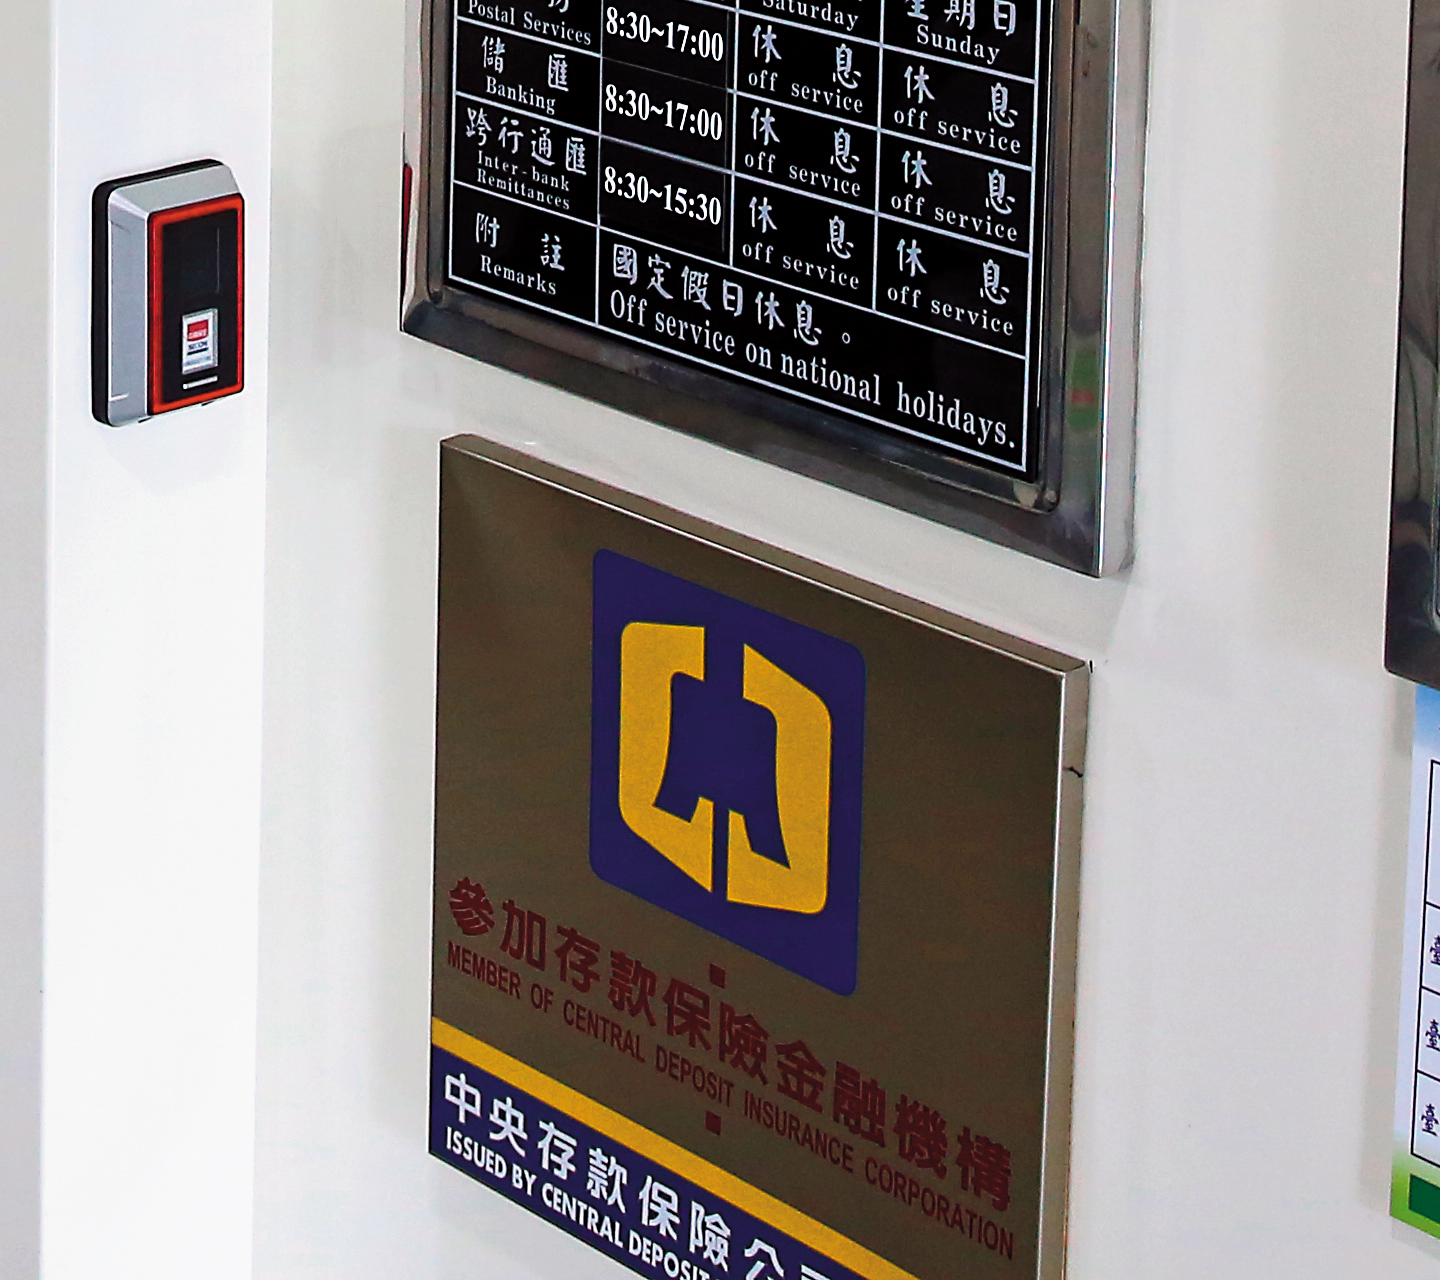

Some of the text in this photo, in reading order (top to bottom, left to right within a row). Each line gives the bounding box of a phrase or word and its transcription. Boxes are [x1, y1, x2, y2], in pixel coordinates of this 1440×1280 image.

[524, 12, 590, 45] Services
[607, 7, 723, 61] 8:30~17:00
[917, 24, 999, 64] Sunday
[482, 36, 568, 91] 儲匯
[753, 25, 861, 89] 休息
[486, 76, 555, 115] Banking
[606, 84, 722, 140] 8:30~17:00
[749, 70, 862, 113] off service
[904, 66, 1018, 127] 休息
[466, 108, 586, 175] 跨行通匯
[751, 107, 859, 173] 休息
[894, 108, 1020, 153] off service
[478, 168, 569, 209] Remittances
[479, 150, 568, 191] Inter-bank
[605, 166, 721, 225] 8:30~15:30
[745, 152, 860, 196] off service
[902, 151, 1015, 214] 休息
[476, 213, 564, 270] 附註
[749, 197, 853, 259] 休息
[891, 194, 1017, 241] off service
[481, 255, 555, 294] Remarks
[743, 243, 858, 289] off service
[897, 239, 1009, 304] 休息
[888, 286, 1012, 335] off service
[611, 290, 1014, 448] Off service on national holidays.
[448, 876, 1014, 1212] 參加存款保險金融機構
[447, 941, 1014, 1261] MEMBER OF CENTRAL DEPOSIT INSURANCE CORPORATION
[445, 1072, 831, 1280] 中央存款保險公
[445, 1126, 507, 1180] ISSUED
[512, 1163, 536, 1196] BY
[541, 1180, 622, 1249] CENTRAL
